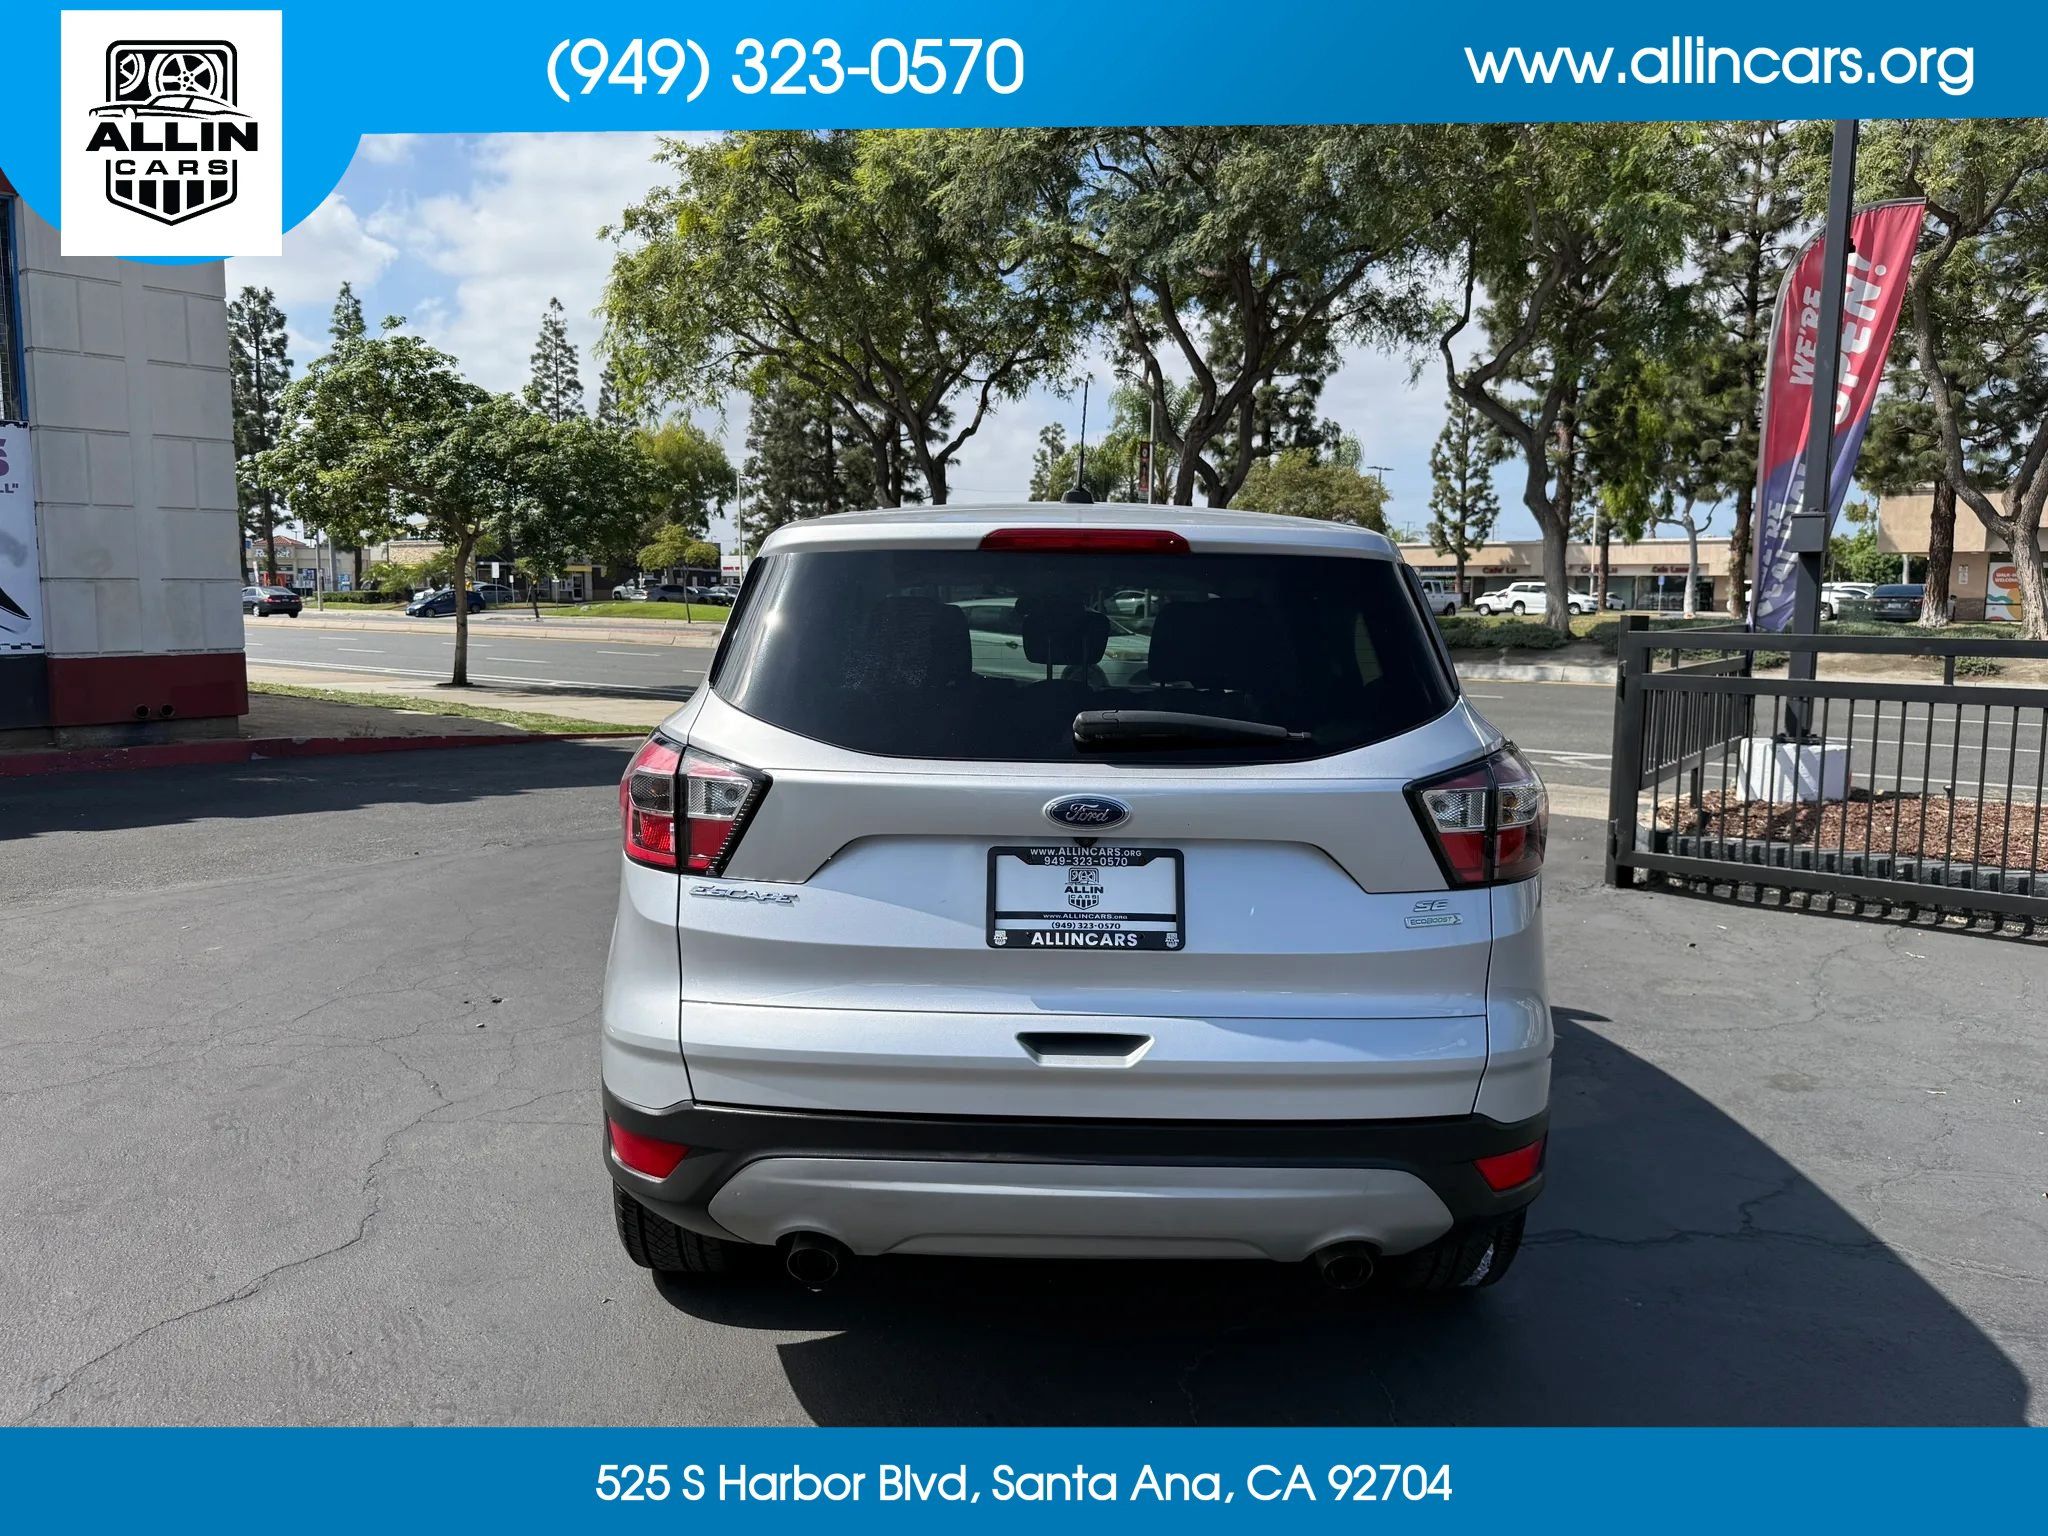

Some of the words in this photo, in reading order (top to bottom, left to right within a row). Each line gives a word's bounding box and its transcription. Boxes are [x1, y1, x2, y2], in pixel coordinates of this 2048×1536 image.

[1065, 803, 1110, 822] Ford
[1044, 856, 1128, 867] 949-323-0570
[689, 885, 800, 904] ESCAPE
[1064, 886, 1104, 894] ALLIN
[1413, 898, 1449, 912] SE
[1051, 921, 1076, 930] (949)
[1078, 921, 1121, 930] 323-0570
[1410, 916, 1453, 926] ECOBOOST
[1031, 931, 1138, 947] ALLINCARS
